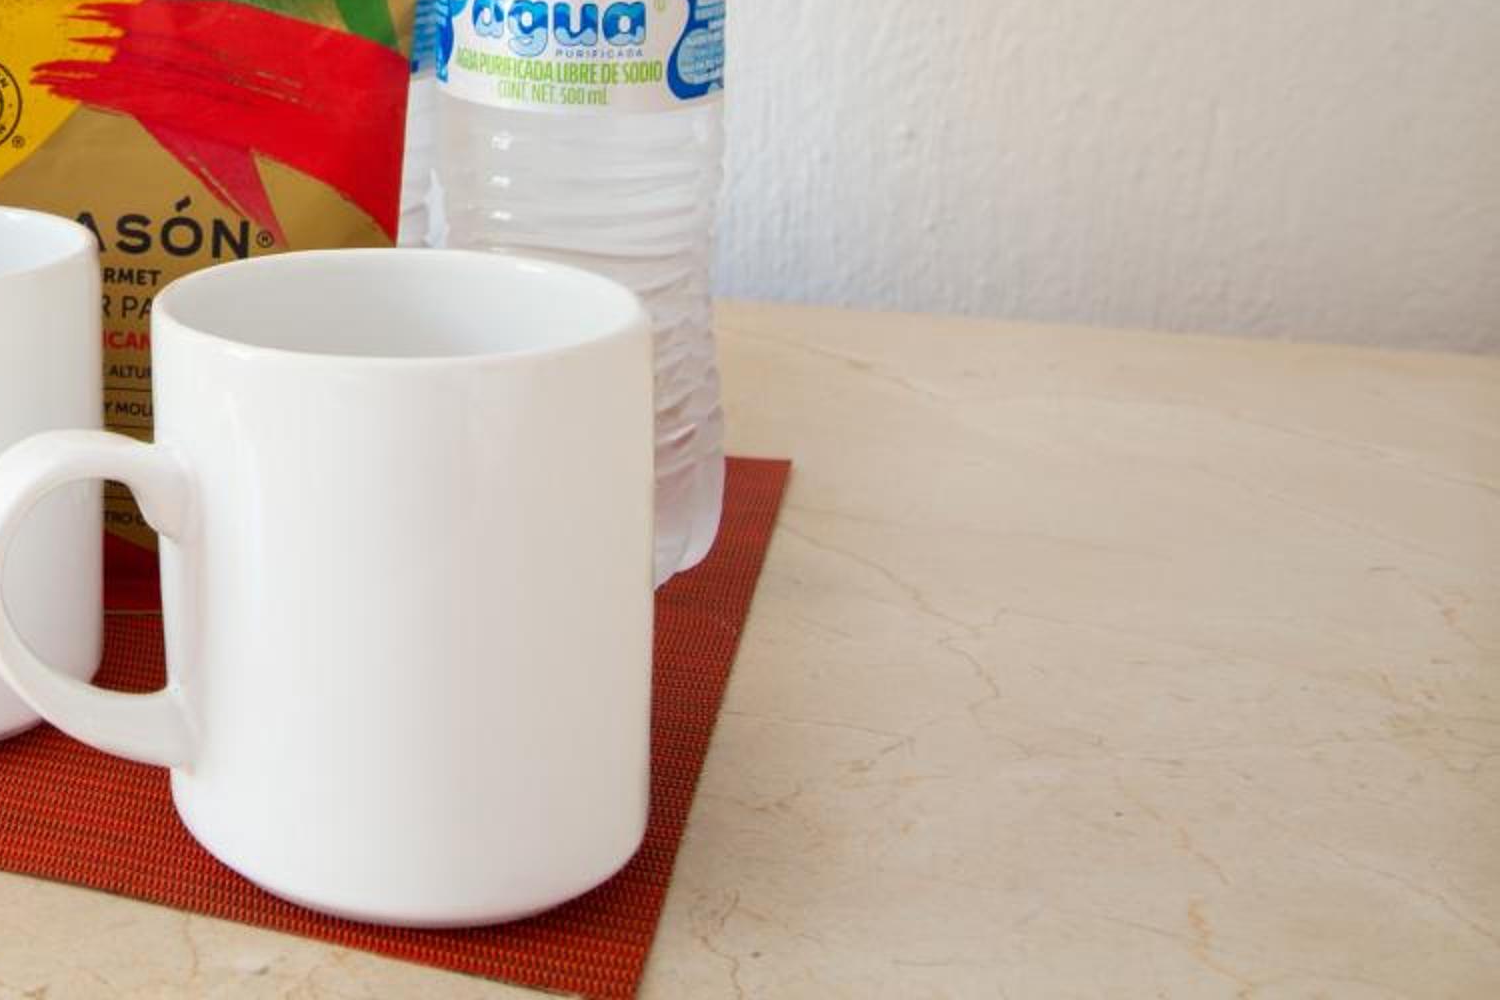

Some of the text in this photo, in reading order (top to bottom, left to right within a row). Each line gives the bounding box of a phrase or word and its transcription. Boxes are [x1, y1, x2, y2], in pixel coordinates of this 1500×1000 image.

[555, 48, 644, 57] PURIFICADA
[479, 52, 553, 82] PURIFICADA
[556, 61, 597, 84] LIBRE
[600, 61, 619, 84] DE
[622, 59, 664, 84] SODIO
